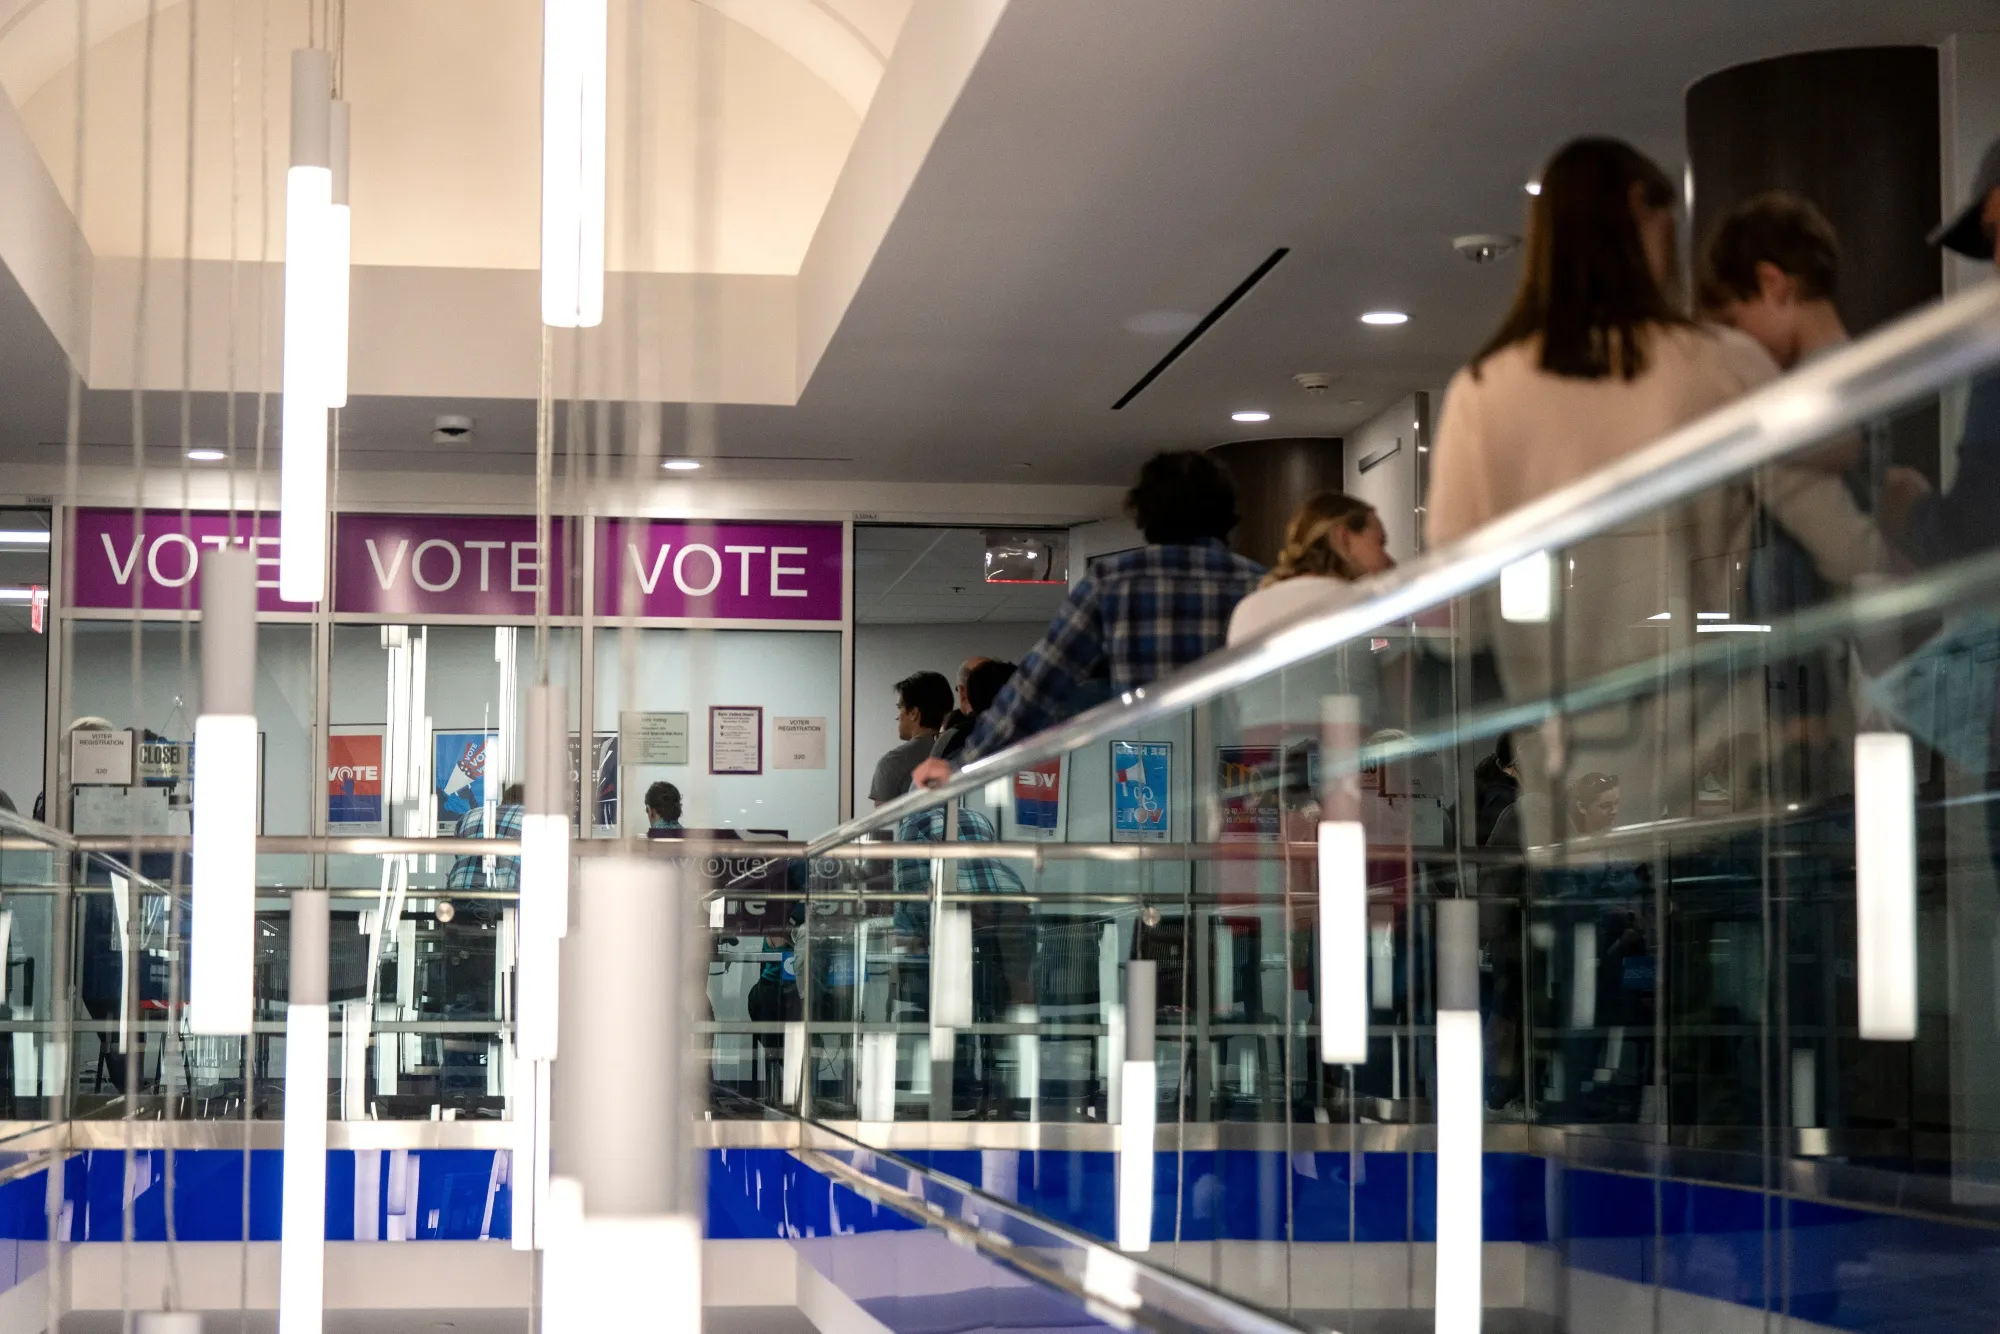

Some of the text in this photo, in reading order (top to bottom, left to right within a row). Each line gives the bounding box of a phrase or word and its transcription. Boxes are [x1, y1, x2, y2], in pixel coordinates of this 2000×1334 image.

[365, 539, 543, 592] VOTE
[627, 543, 808, 597] VOTE
[464, 742, 478, 761] VOTE
[328, 766, 378, 781] VOTE
